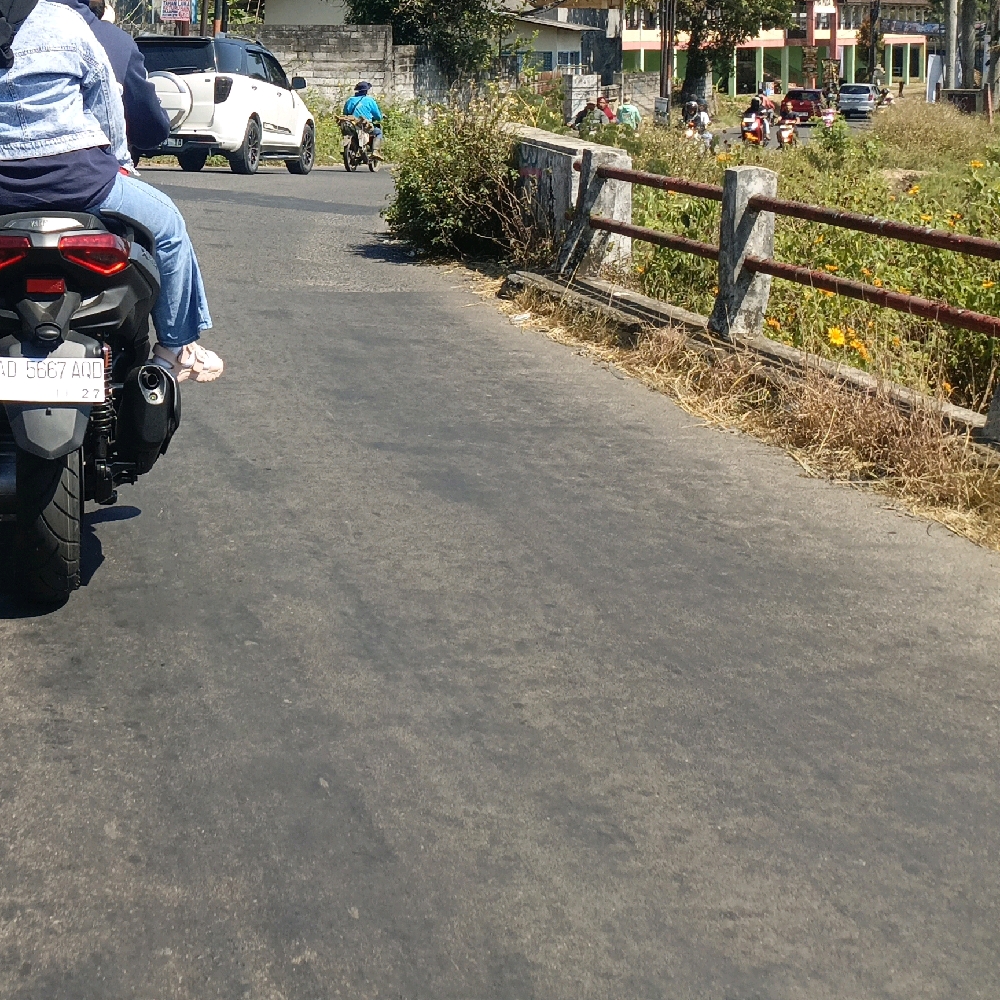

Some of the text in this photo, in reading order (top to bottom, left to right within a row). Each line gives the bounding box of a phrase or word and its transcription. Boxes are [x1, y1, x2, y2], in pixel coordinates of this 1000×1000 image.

[26, 360, 67, 379] 5667
[71, 360, 103, 379] AQD
[81, 388, 100, 399] 27
